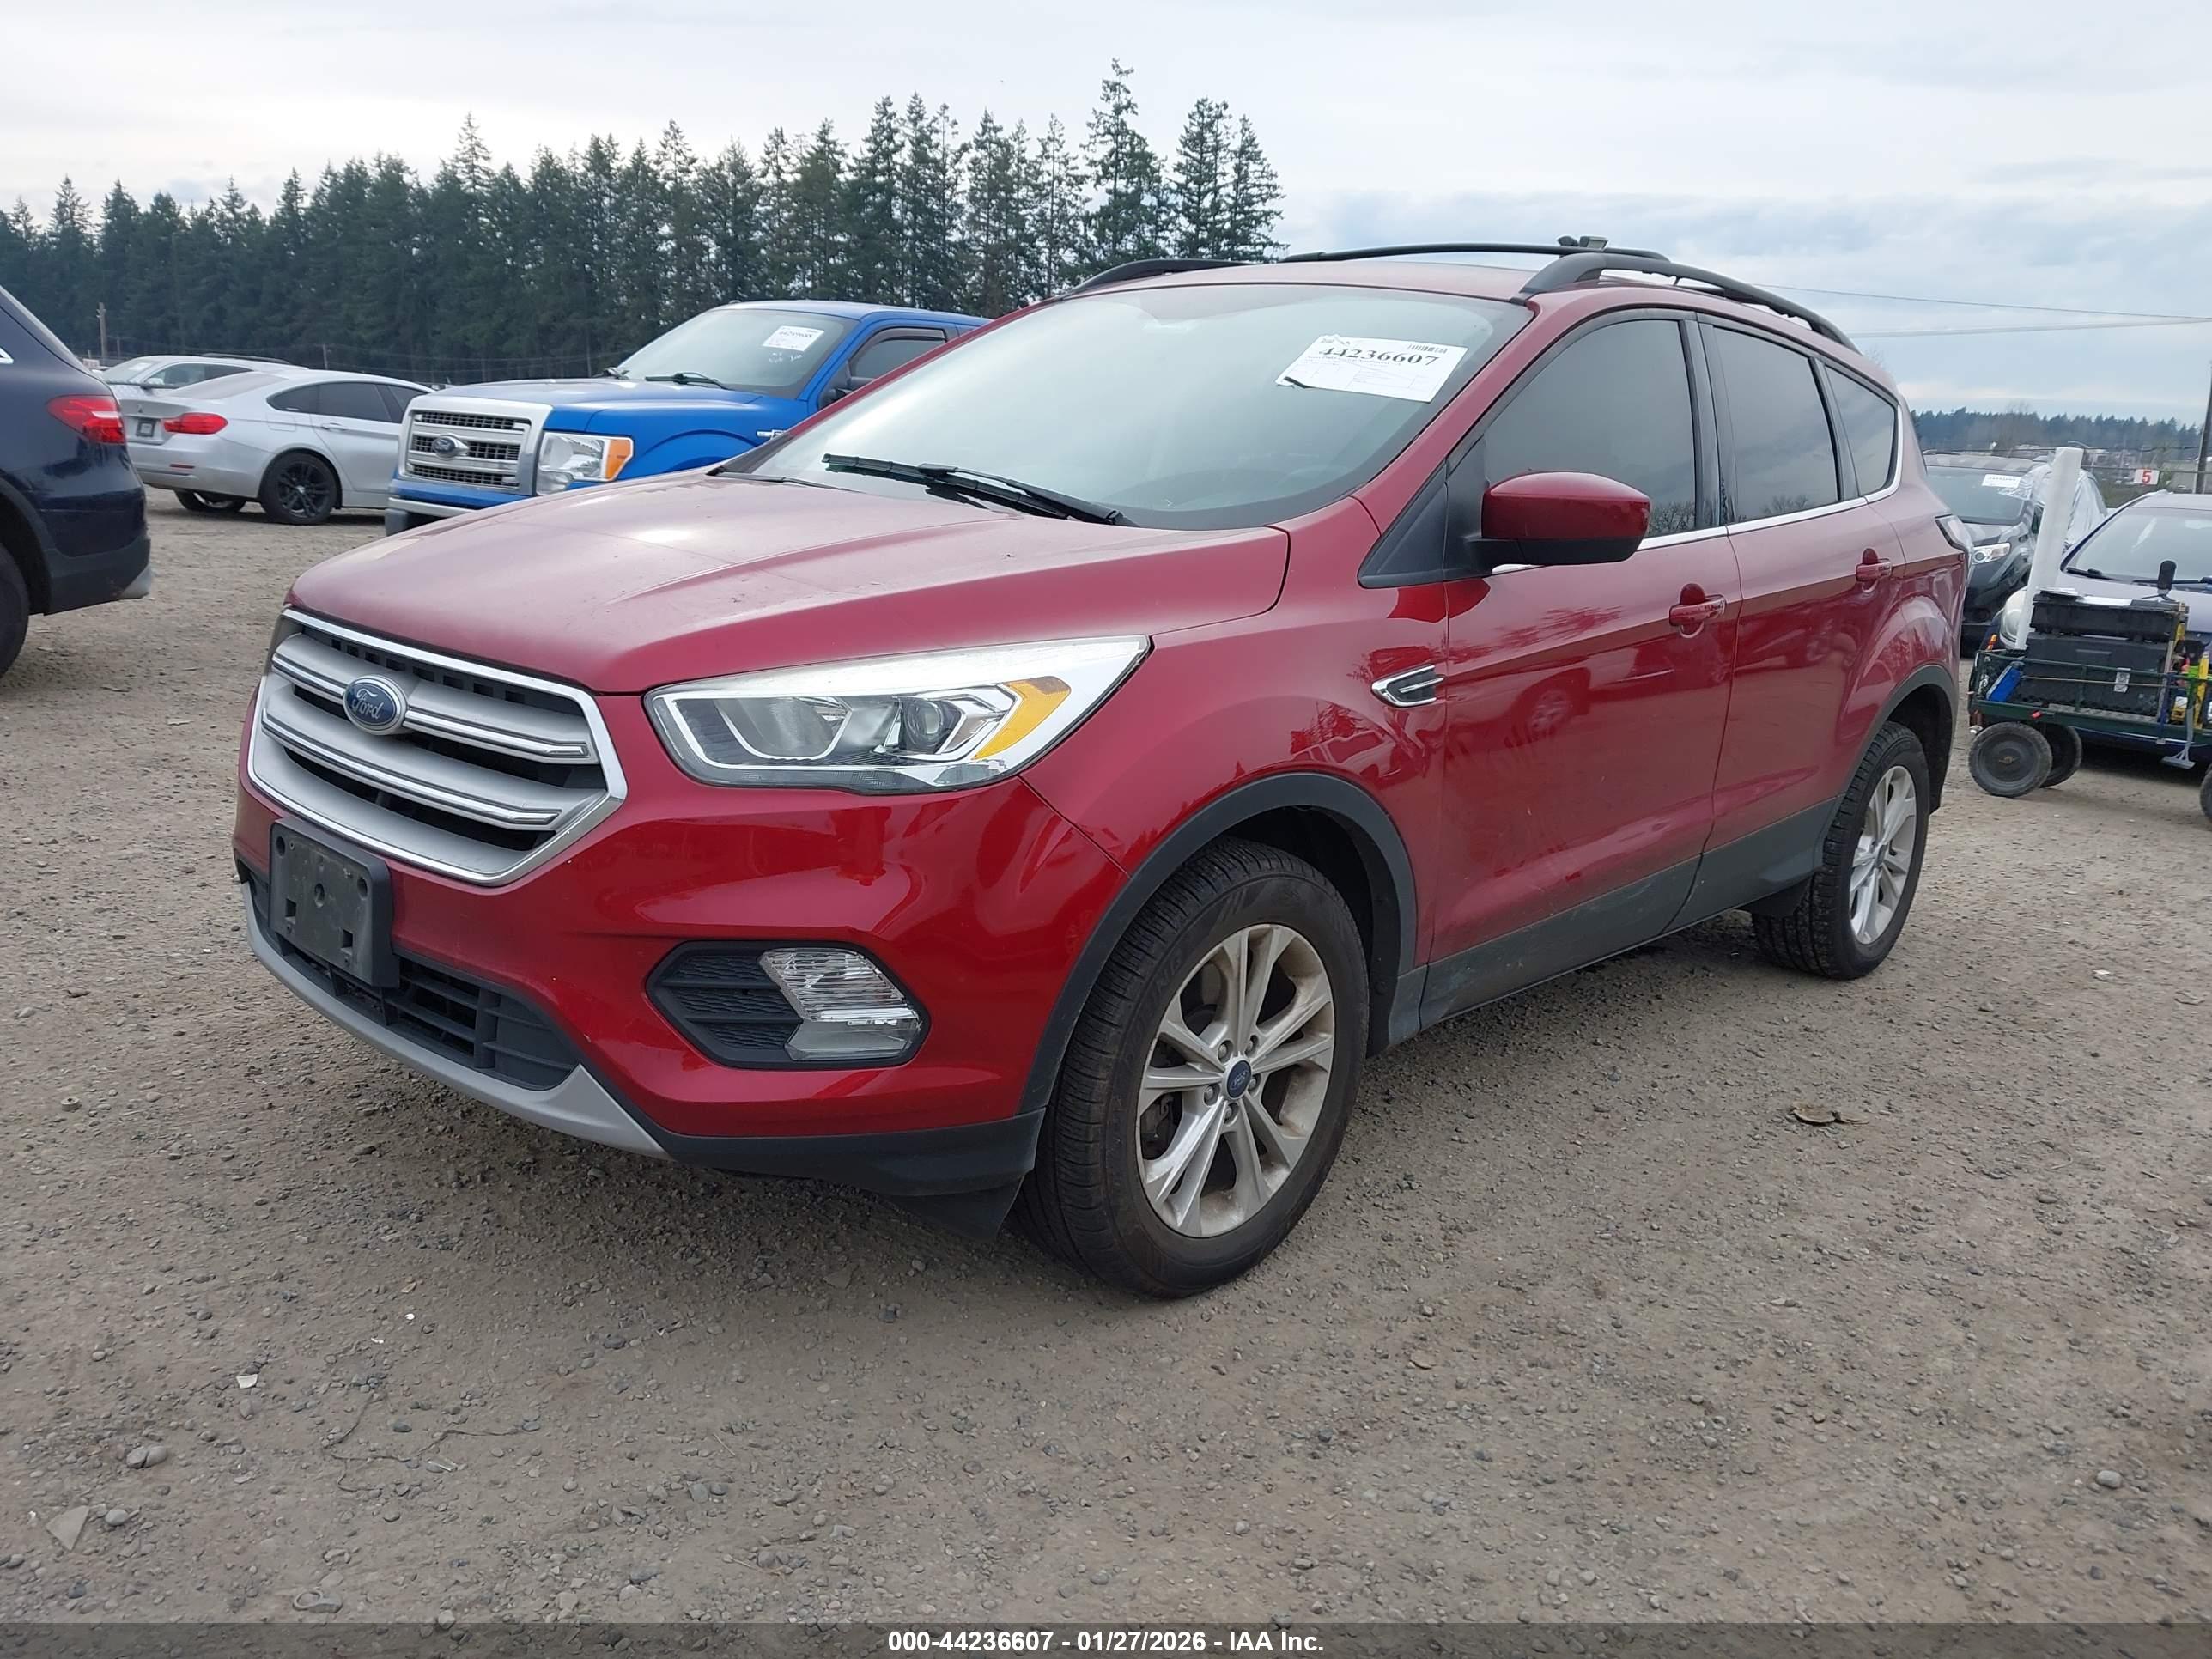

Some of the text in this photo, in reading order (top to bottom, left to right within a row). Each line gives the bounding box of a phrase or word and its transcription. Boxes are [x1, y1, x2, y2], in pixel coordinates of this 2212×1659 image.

[1318, 347, 1440, 366] 44236607
[2142, 470, 2152, 483] 5
[351, 688, 385, 720] Ford
